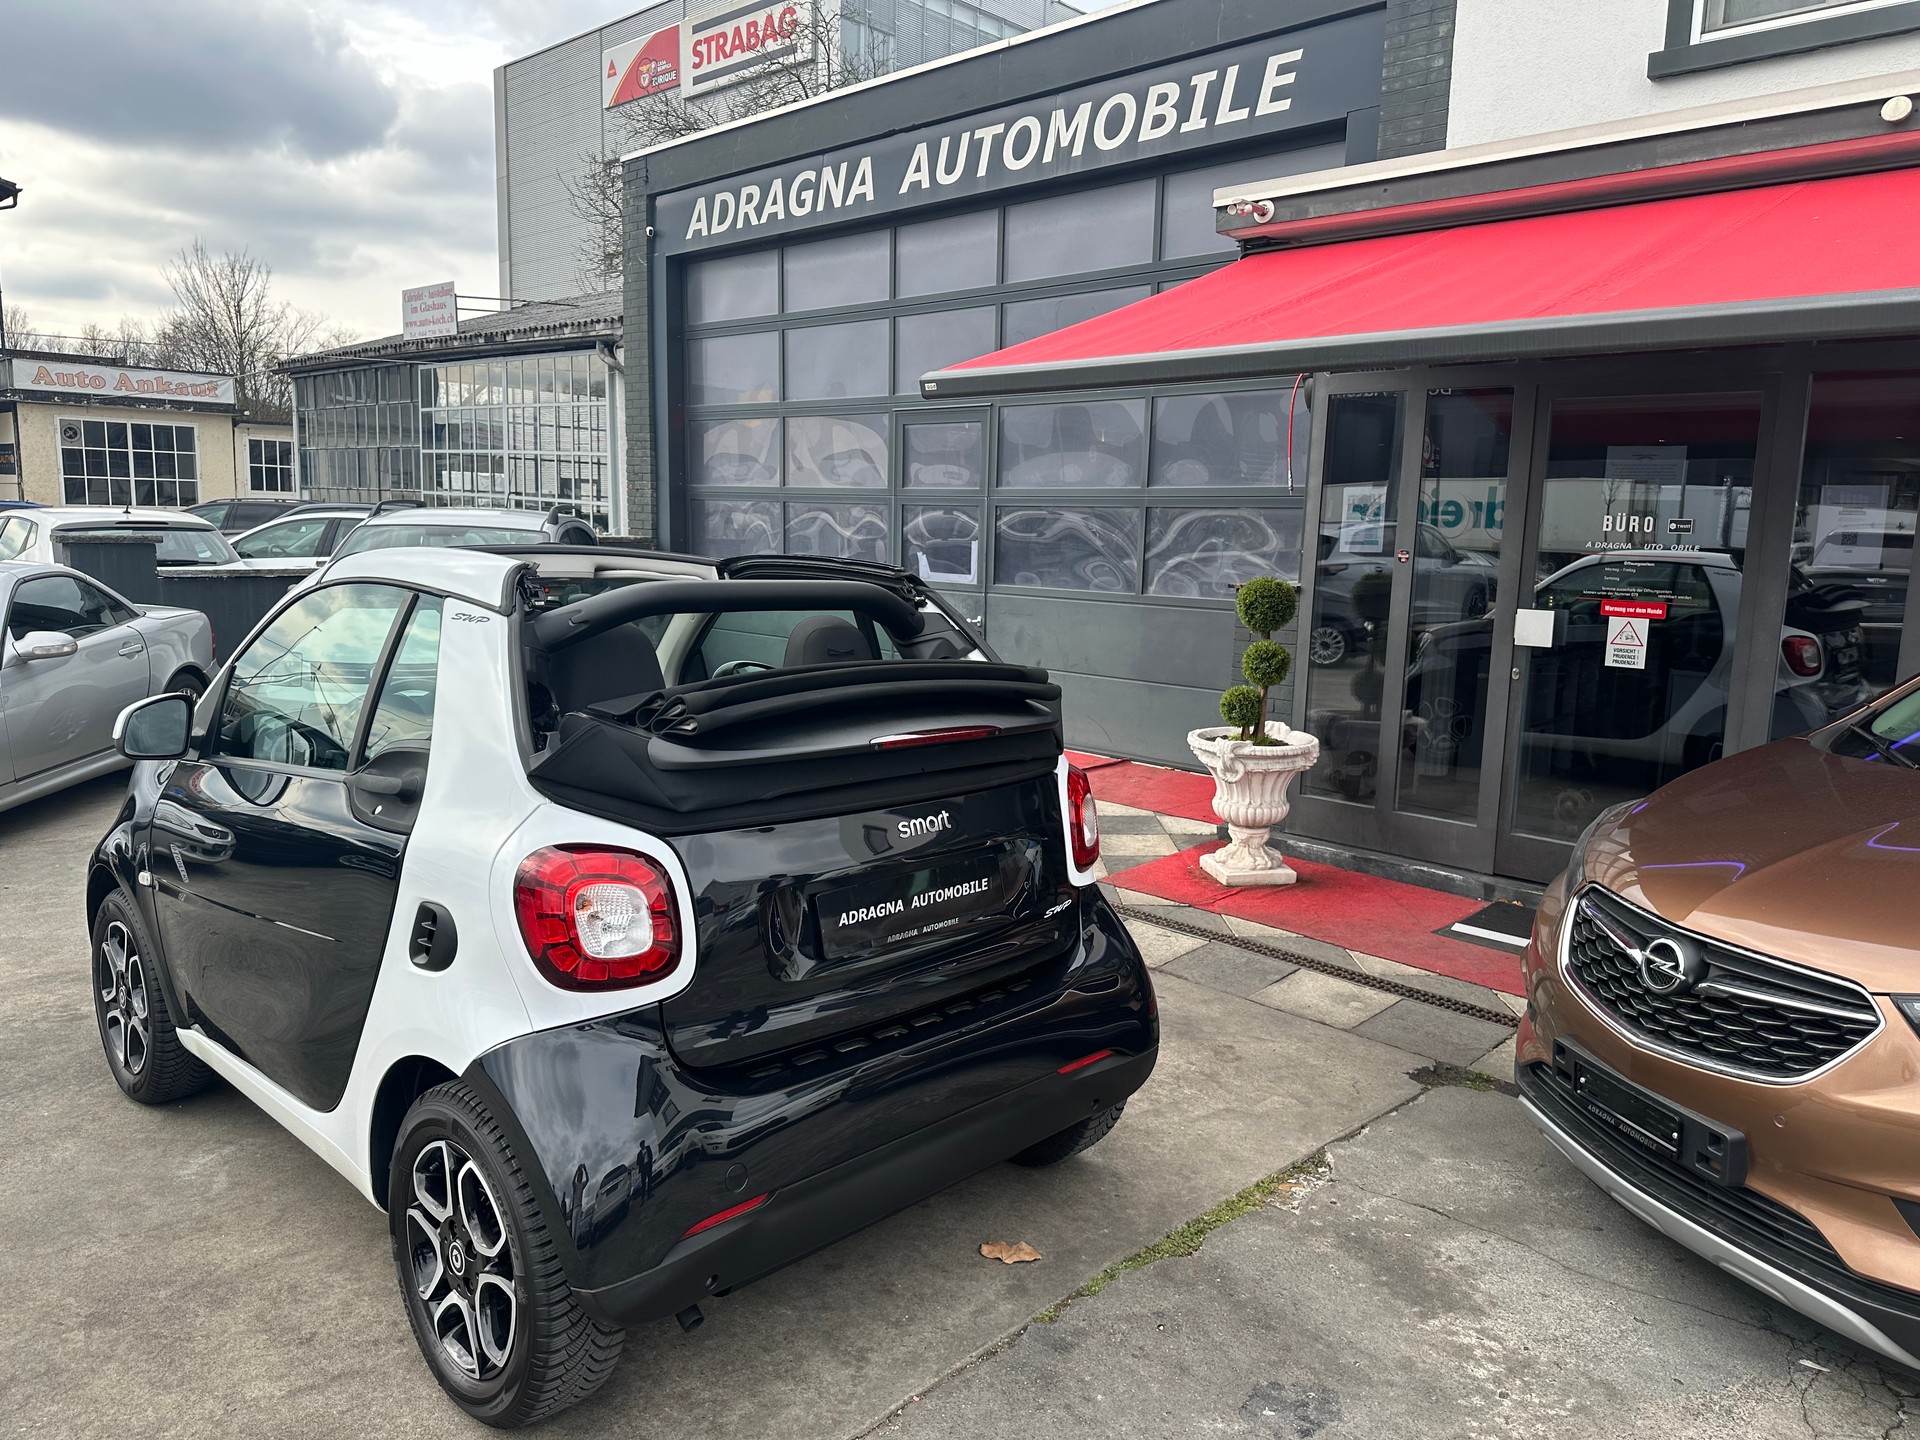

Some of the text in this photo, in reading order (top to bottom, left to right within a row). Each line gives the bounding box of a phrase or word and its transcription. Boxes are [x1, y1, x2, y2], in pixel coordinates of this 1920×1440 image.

[692, 7, 798, 69] STRABAG
[685, 49, 1304, 240] ADRAGNA AUTOMOBILE
[420, 301, 446, 312] Glashaus
[32, 366, 219, 398] Auto Ankauf
[1602, 513, 1654, 533] BÜRO
[1604, 605, 1626, 613] Warnung
[898, 810, 951, 839] smart
[839, 878, 989, 927] ADRAGNA AUTOMOBILE
[887, 917, 959, 943] ADRAGNA AUTOMOBILE
[1587, 1104, 1657, 1150] ADRAGNA AUTOMOBILE
